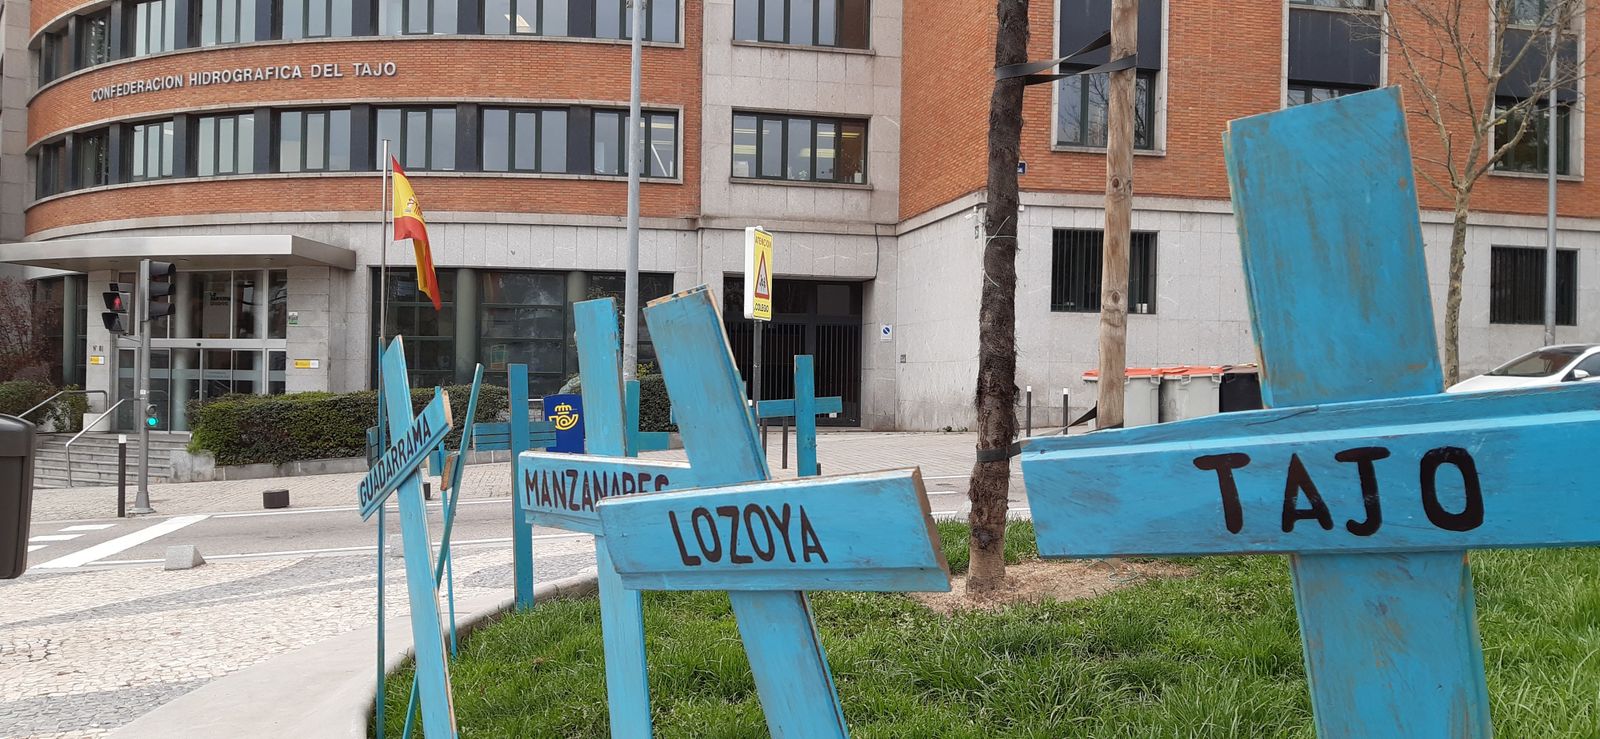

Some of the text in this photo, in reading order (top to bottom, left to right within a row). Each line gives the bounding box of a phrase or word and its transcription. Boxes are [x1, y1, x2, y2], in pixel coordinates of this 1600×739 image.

[91, 61, 397, 102] CONFEDERACION HIDROGRAFICA DEL TAJO
[754, 302, 769, 313] COLEGIO
[360, 412, 432, 508] GUADARRAMA
[1193, 446, 1484, 536] TAJO
[668, 502, 829, 566] LOZOYA
